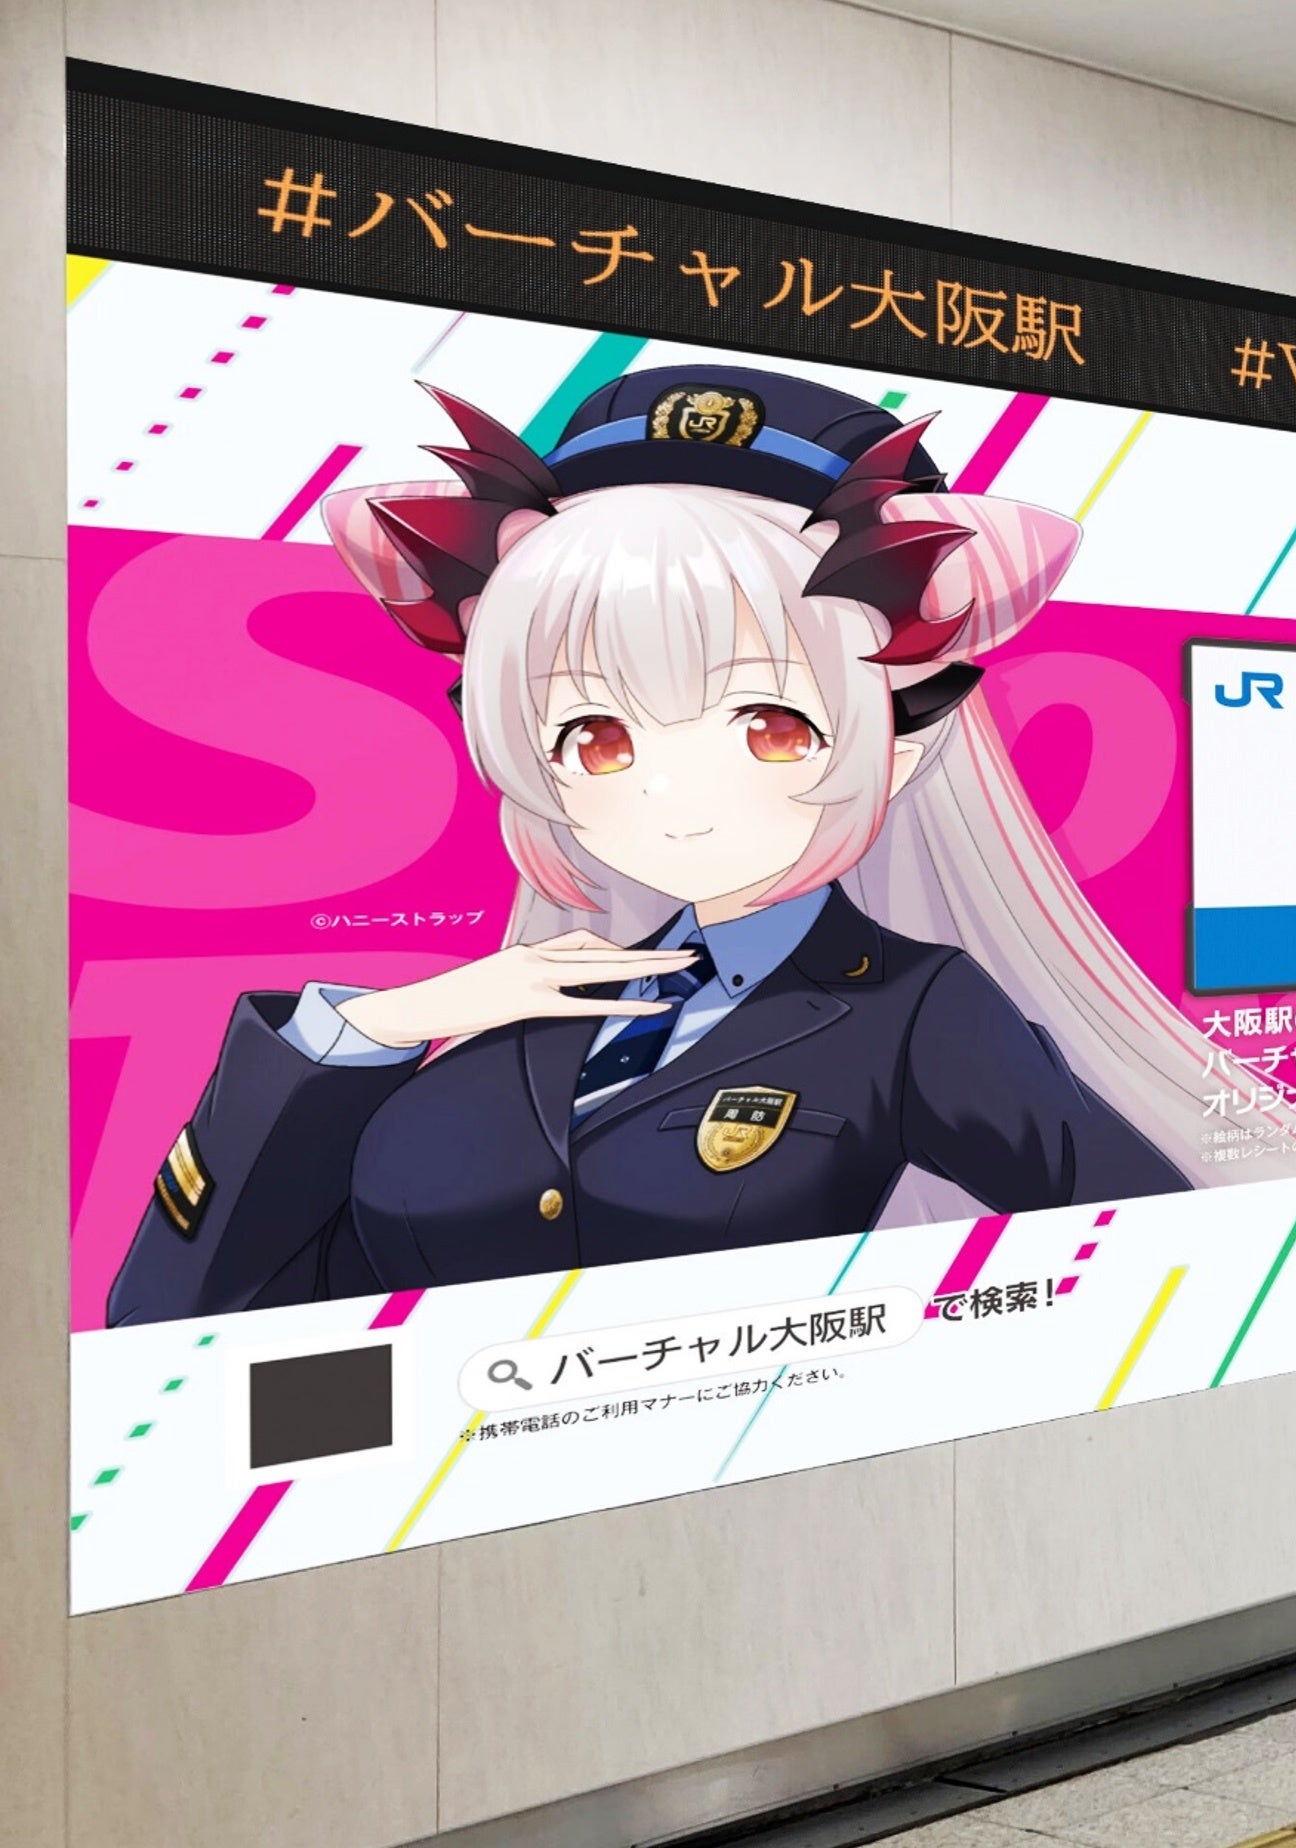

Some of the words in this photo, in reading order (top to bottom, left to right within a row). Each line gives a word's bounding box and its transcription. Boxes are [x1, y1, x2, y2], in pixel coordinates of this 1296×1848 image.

[258, 168, 1088, 367] #バーチャル大阪駅
[1214, 671, 1285, 710] JR
[550, 1302, 888, 1386] バーチャル大阪駅
[932, 1278, 1057, 1325] で検索!
